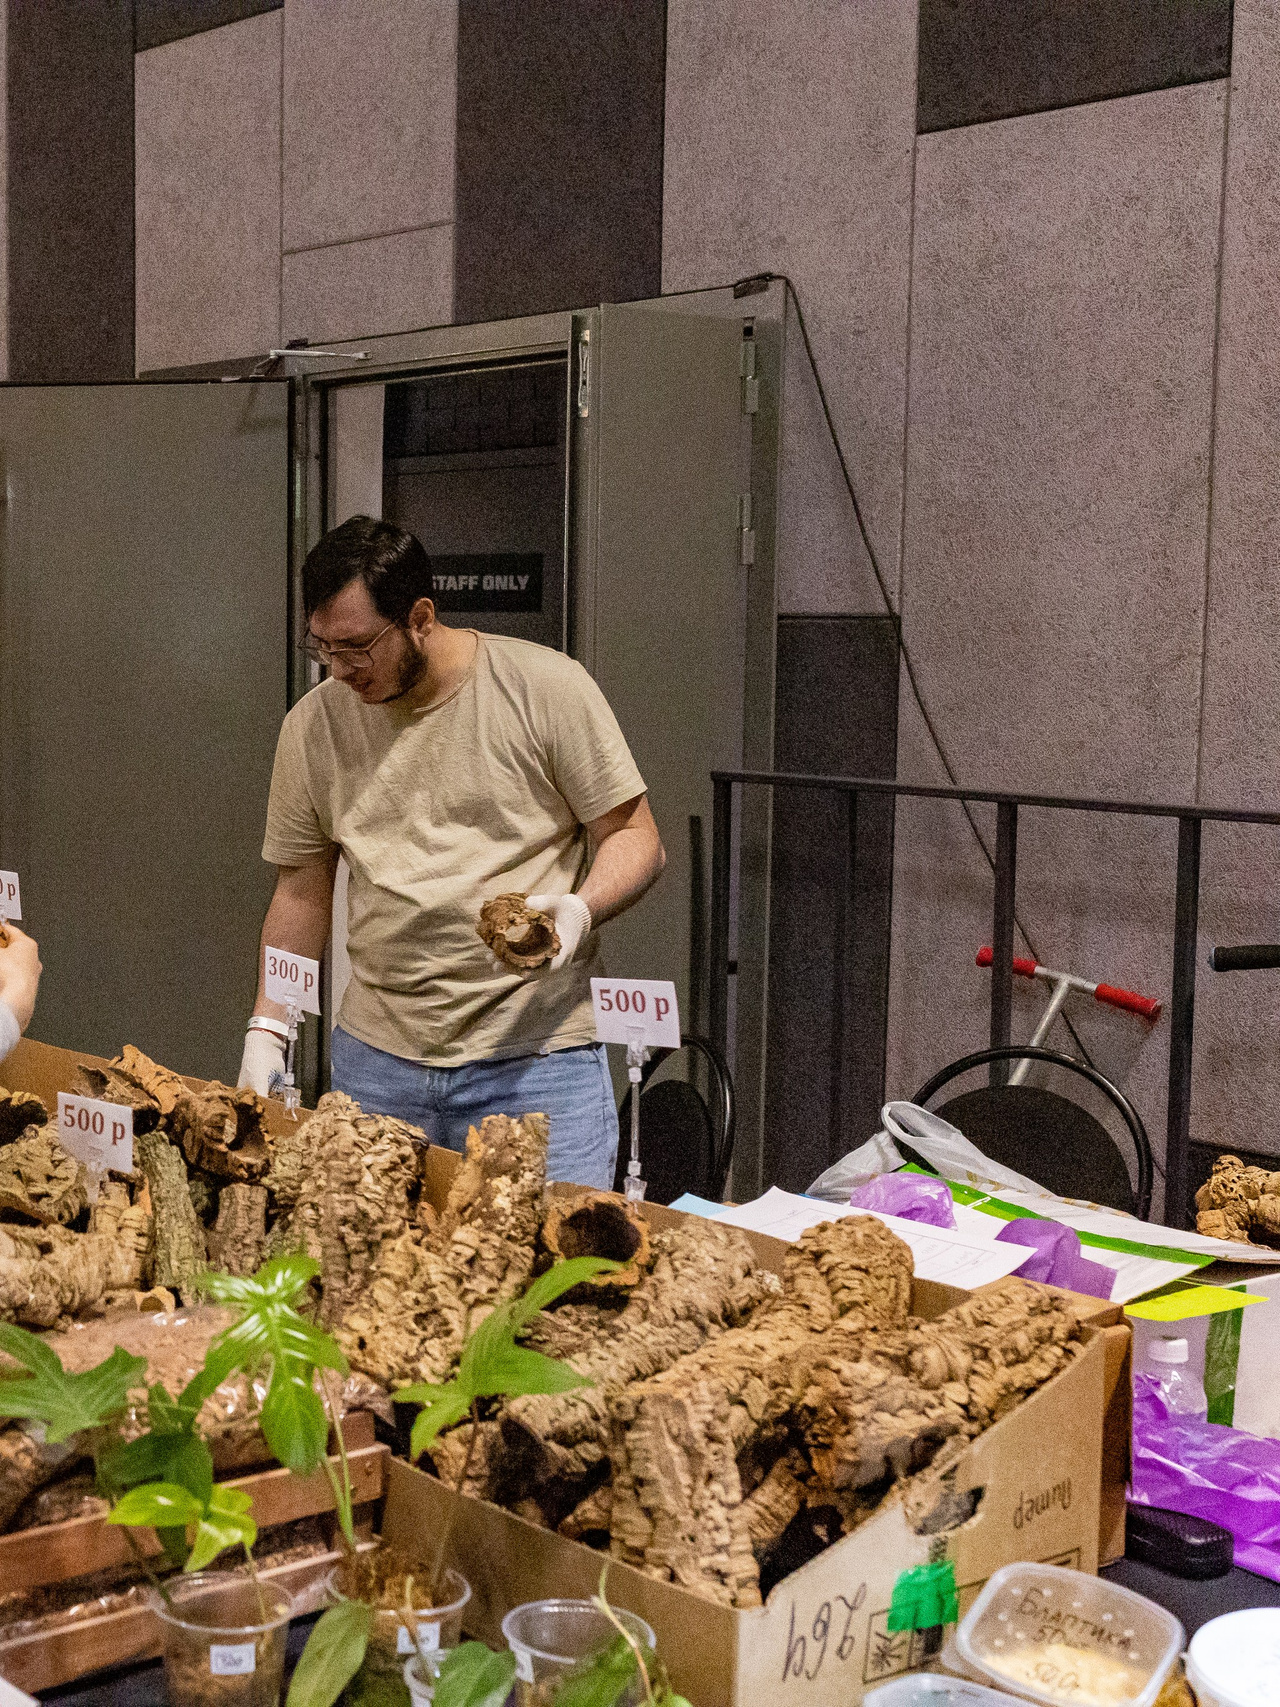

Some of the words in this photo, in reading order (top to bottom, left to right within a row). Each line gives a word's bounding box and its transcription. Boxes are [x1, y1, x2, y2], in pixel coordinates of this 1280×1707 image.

[482, 575, 530, 591] ONLY
[268, 955, 299, 983] 300
[599, 988, 646, 1013] 500
[63, 1103, 105, 1136] 500
